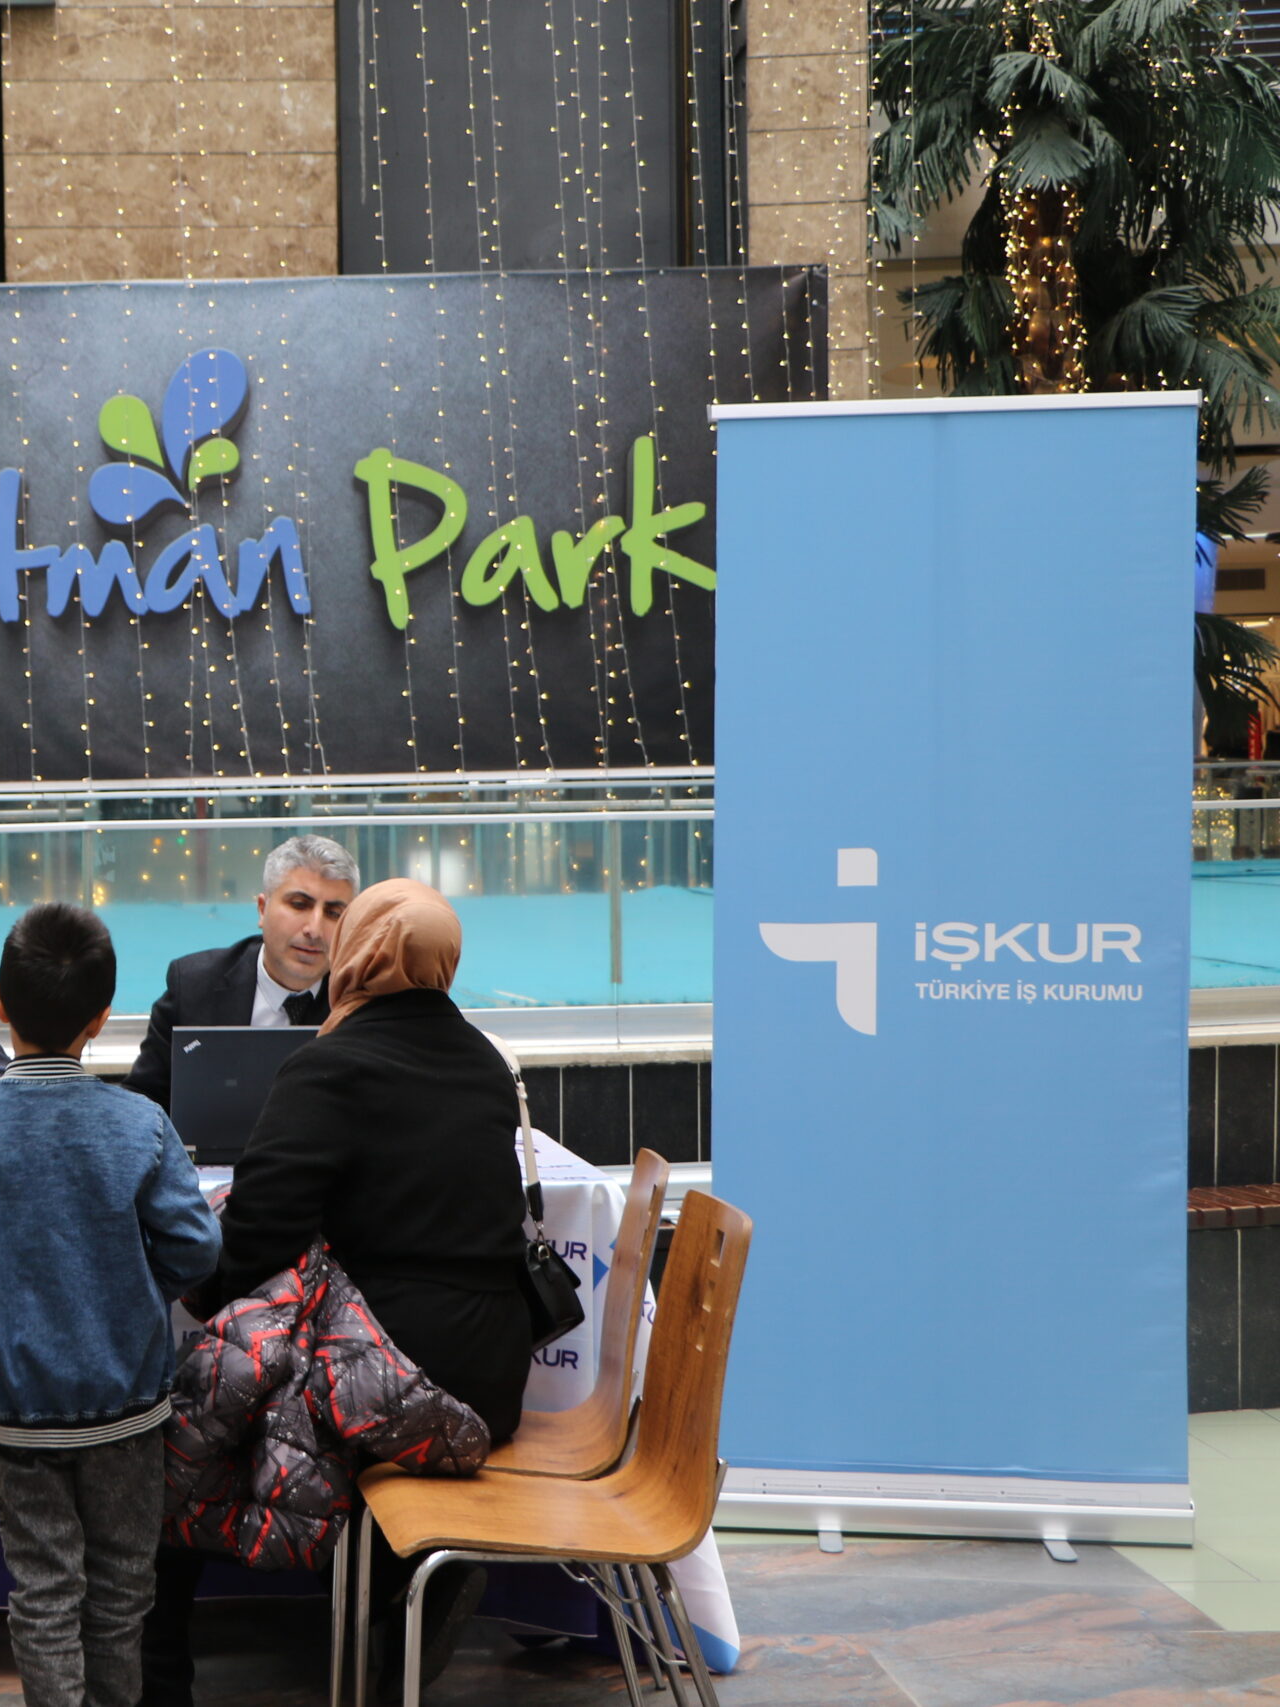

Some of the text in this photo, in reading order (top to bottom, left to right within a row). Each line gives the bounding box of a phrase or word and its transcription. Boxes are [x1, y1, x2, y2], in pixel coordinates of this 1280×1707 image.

[354, 435, 714, 629] Park
[915, 978, 1143, 1004] TÜRKİYE İŞ KURUMU
